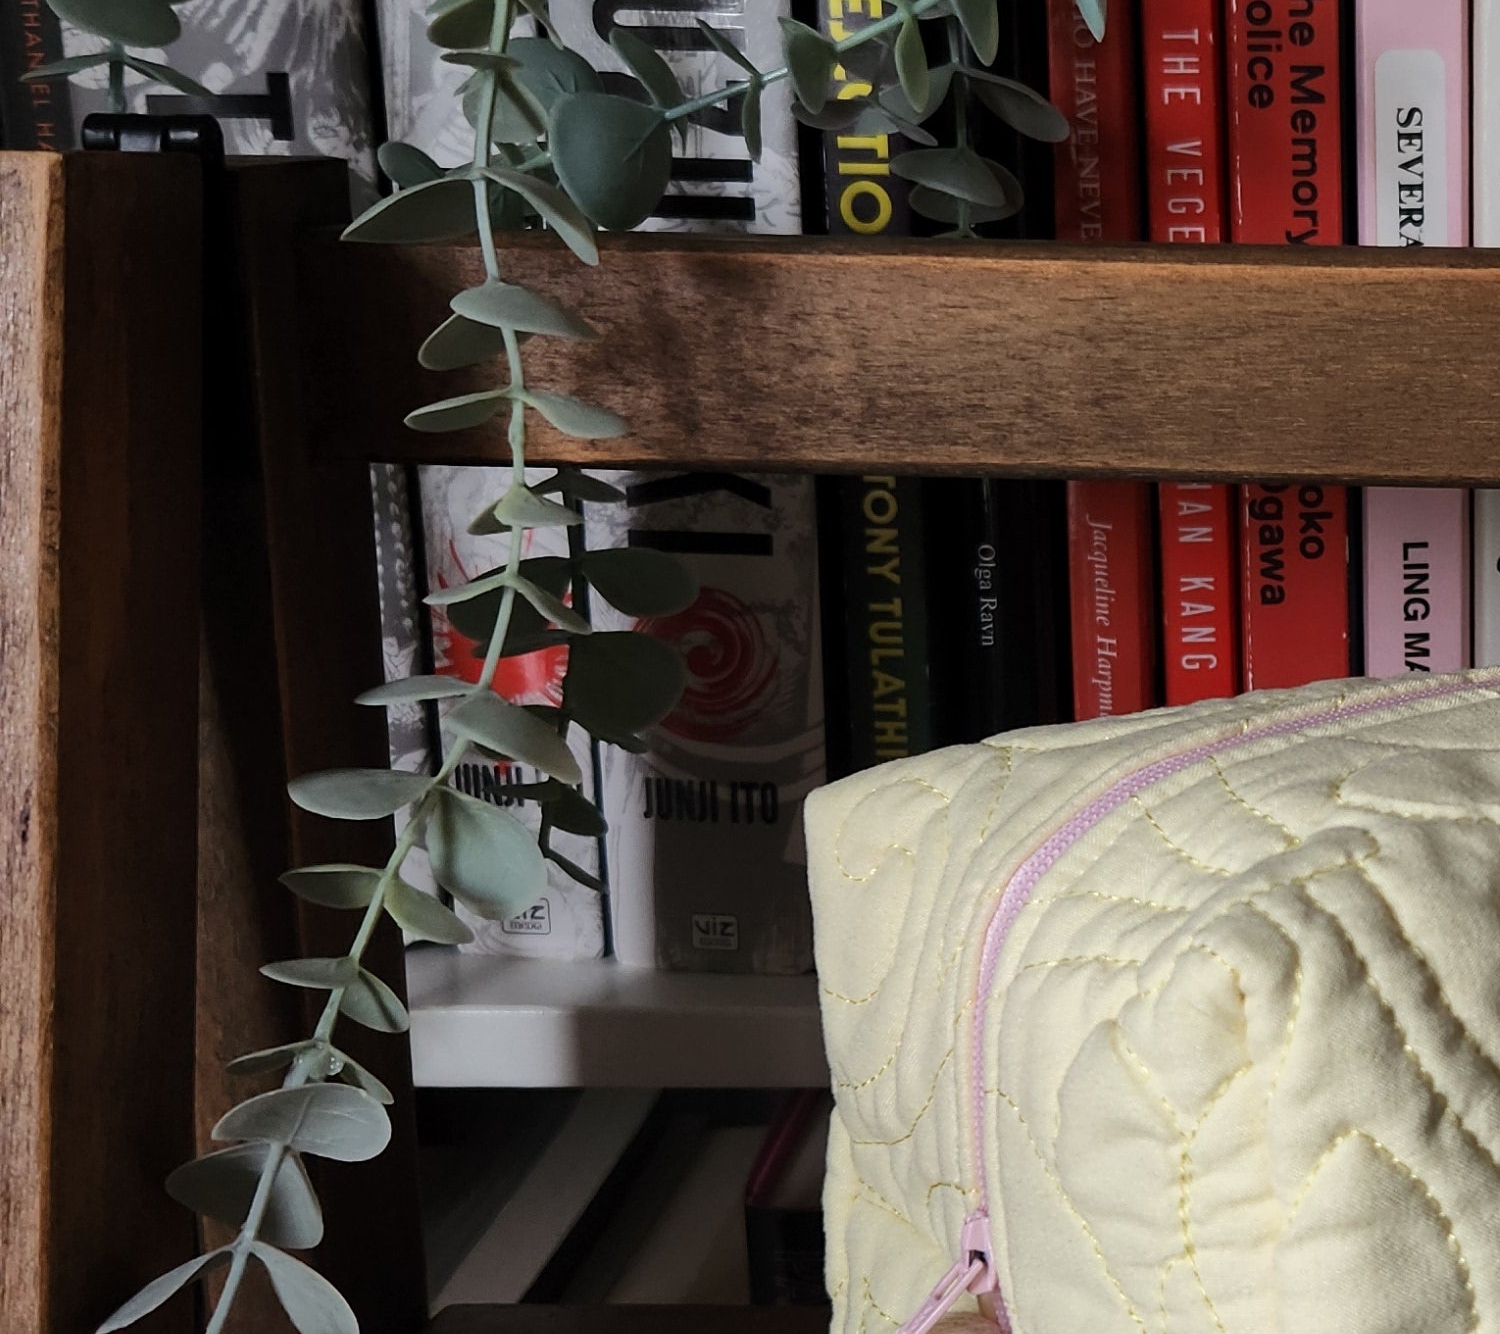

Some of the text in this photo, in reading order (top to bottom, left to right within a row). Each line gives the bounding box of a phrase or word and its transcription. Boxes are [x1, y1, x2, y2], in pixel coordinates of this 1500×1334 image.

[1074, 59, 1099, 147] HAVE
[1161, 27, 1207, 244] THE VEGE
[1078, 153, 1103, 243] NEVE
[1286, 63, 1326, 246] Memory
[1395, 106, 1426, 248] SEVERA
[1297, 484, 1335, 562] oko
[862, 474, 909, 758] TONY TULATHI
[974, 544, 999, 647] Olga Ravn
[1086, 513, 1119, 715] Jacqueline Harpm
[1180, 575, 1218, 673] KANG
[1402, 541, 1432, 623] LING
[643, 776, 779, 826] JUNJI ITO
